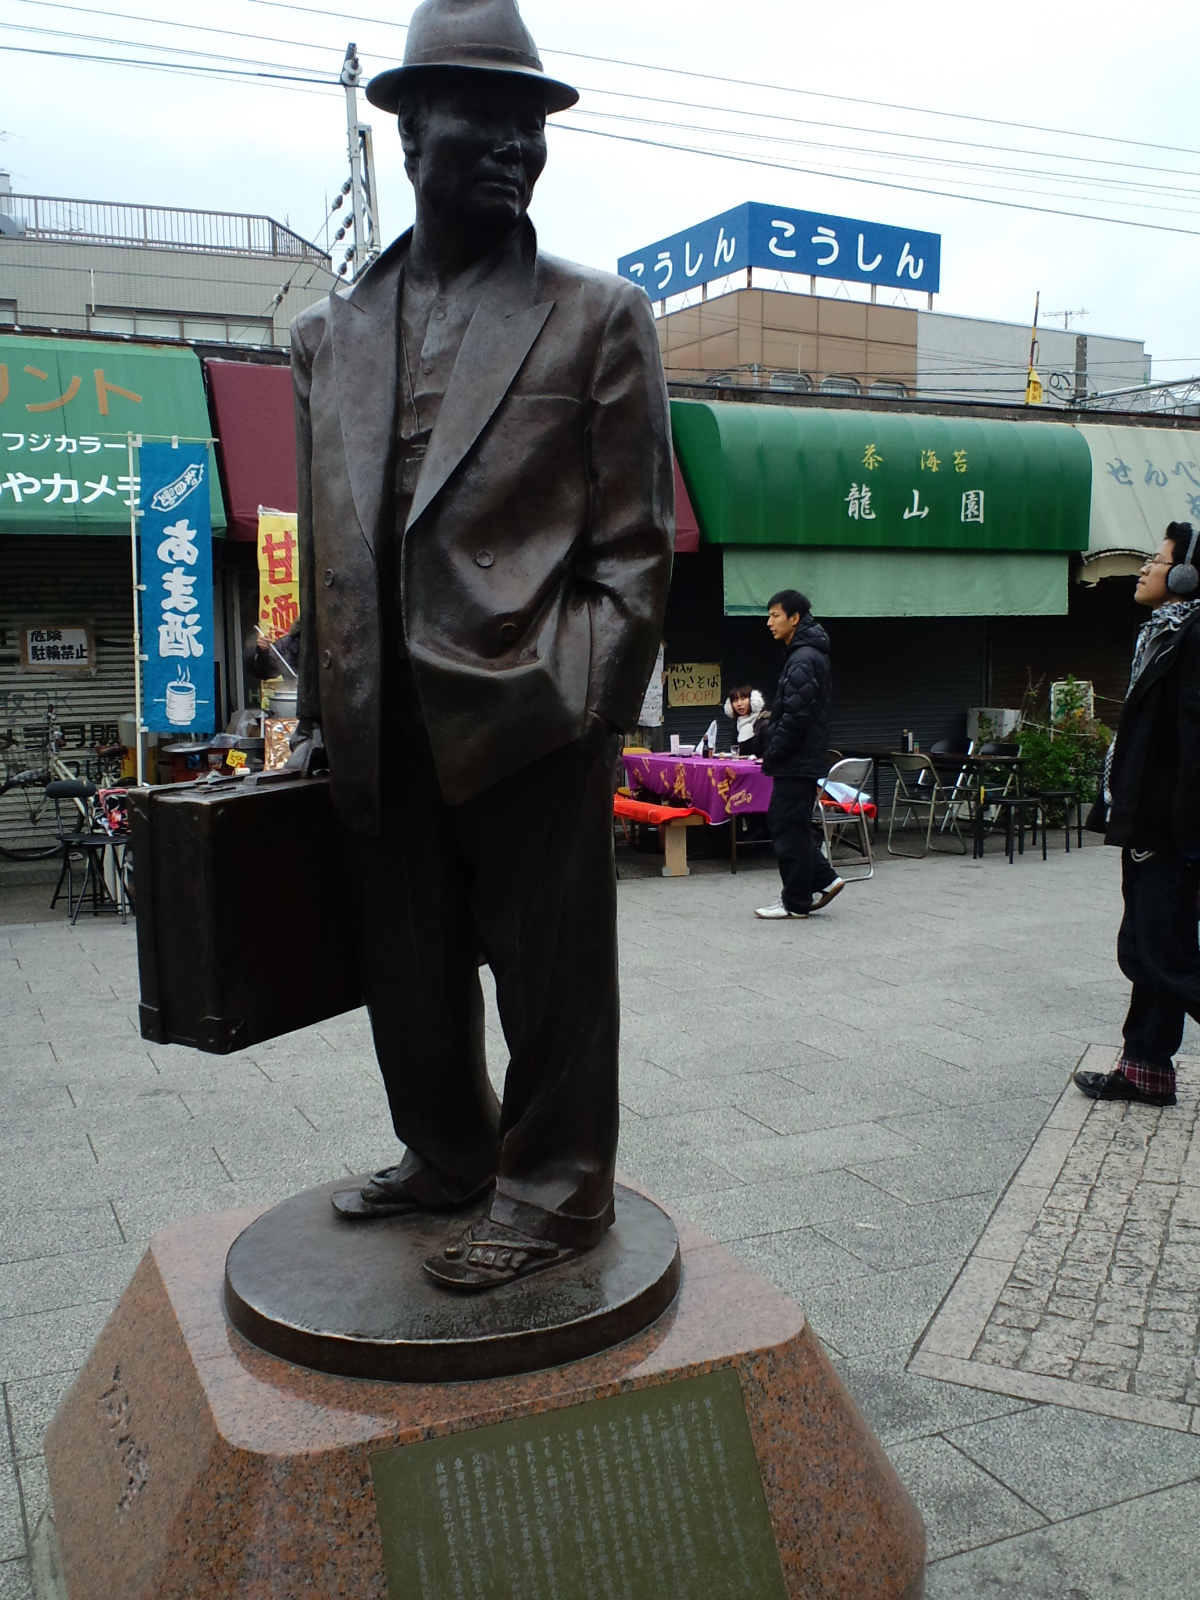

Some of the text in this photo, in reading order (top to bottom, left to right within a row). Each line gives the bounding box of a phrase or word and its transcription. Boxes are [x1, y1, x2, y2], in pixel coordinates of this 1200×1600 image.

[768, 219, 924, 280] こうしん
[2, 432, 127, 455] フジカラー
[861, 444, 969, 474] 茶 海苔
[844, 483, 985, 524] 龍山園
[30, 629, 63, 643] 危険
[31, 644, 88, 662] 駐輪禁止
